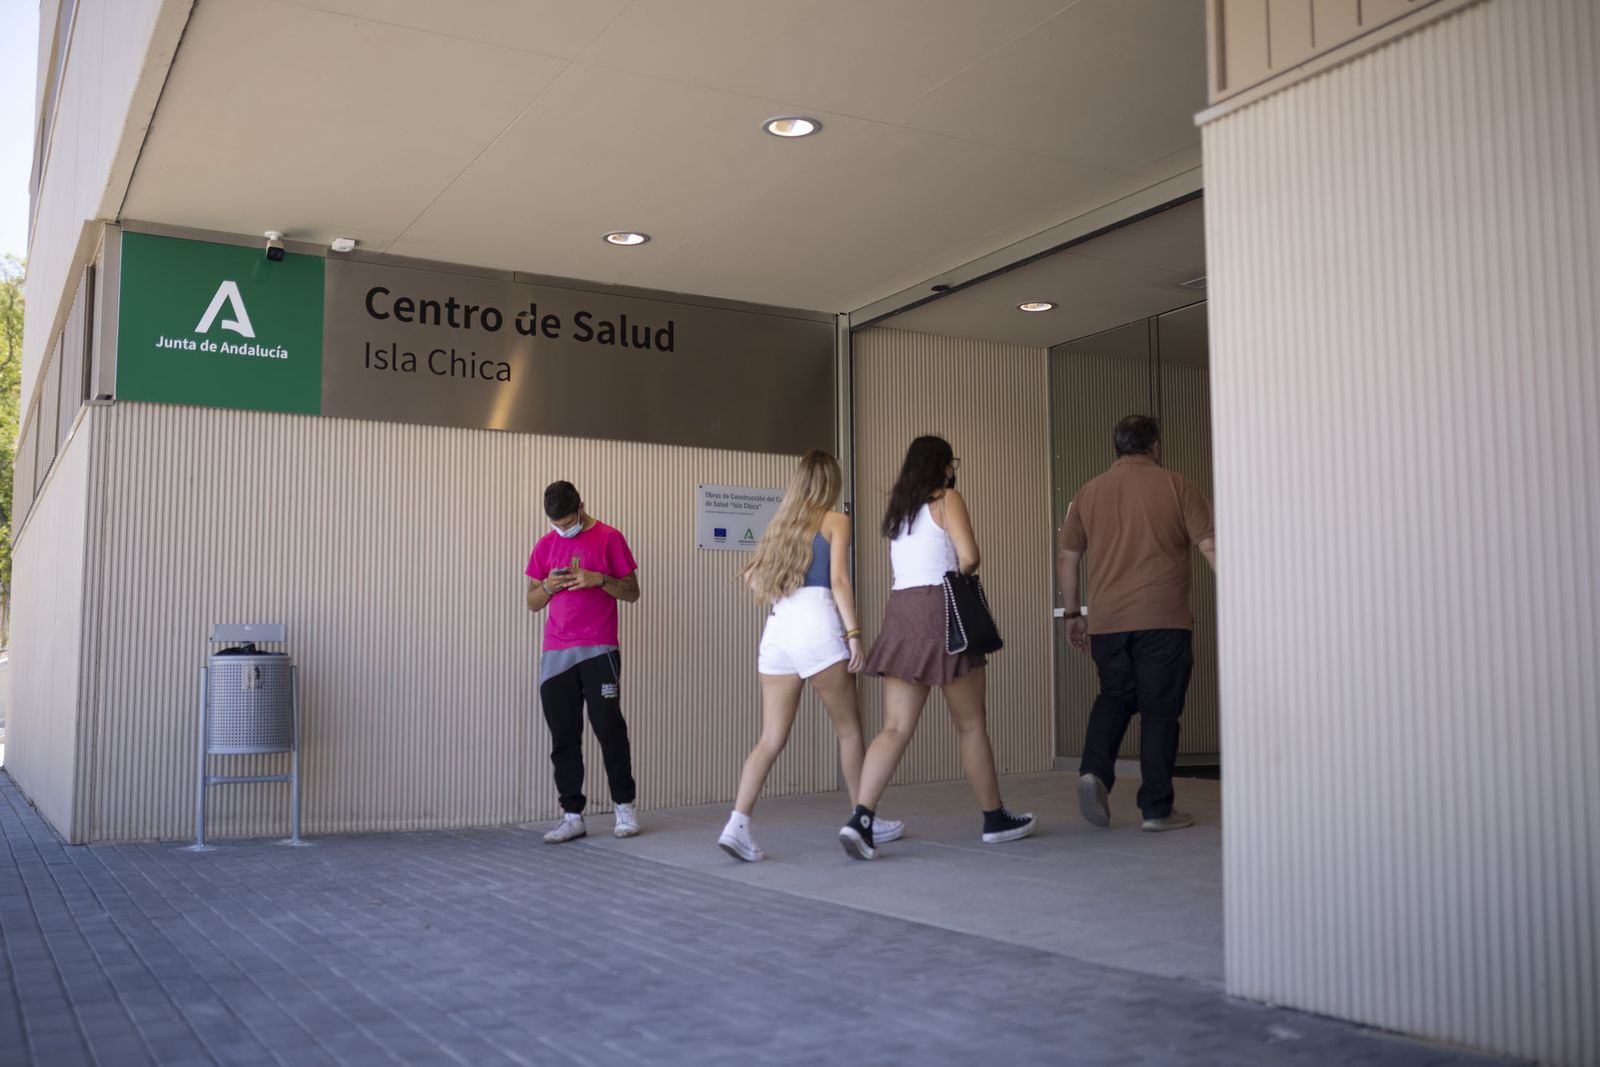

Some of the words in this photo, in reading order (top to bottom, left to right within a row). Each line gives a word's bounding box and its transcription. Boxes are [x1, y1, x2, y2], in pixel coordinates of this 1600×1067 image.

[365, 286, 503, 332] Centro
[514, 303, 561, 339] de
[572, 310, 675, 352] Salud
[156, 335, 196, 350] Junta
[200, 340, 217, 352] de
[220, 342, 288, 359] Andalucía
[364, 341, 417, 373] Isla
[427, 347, 512, 382] Chica
[705, 491, 721, 499] Obras
[730, 493, 766, 502] Construcción
